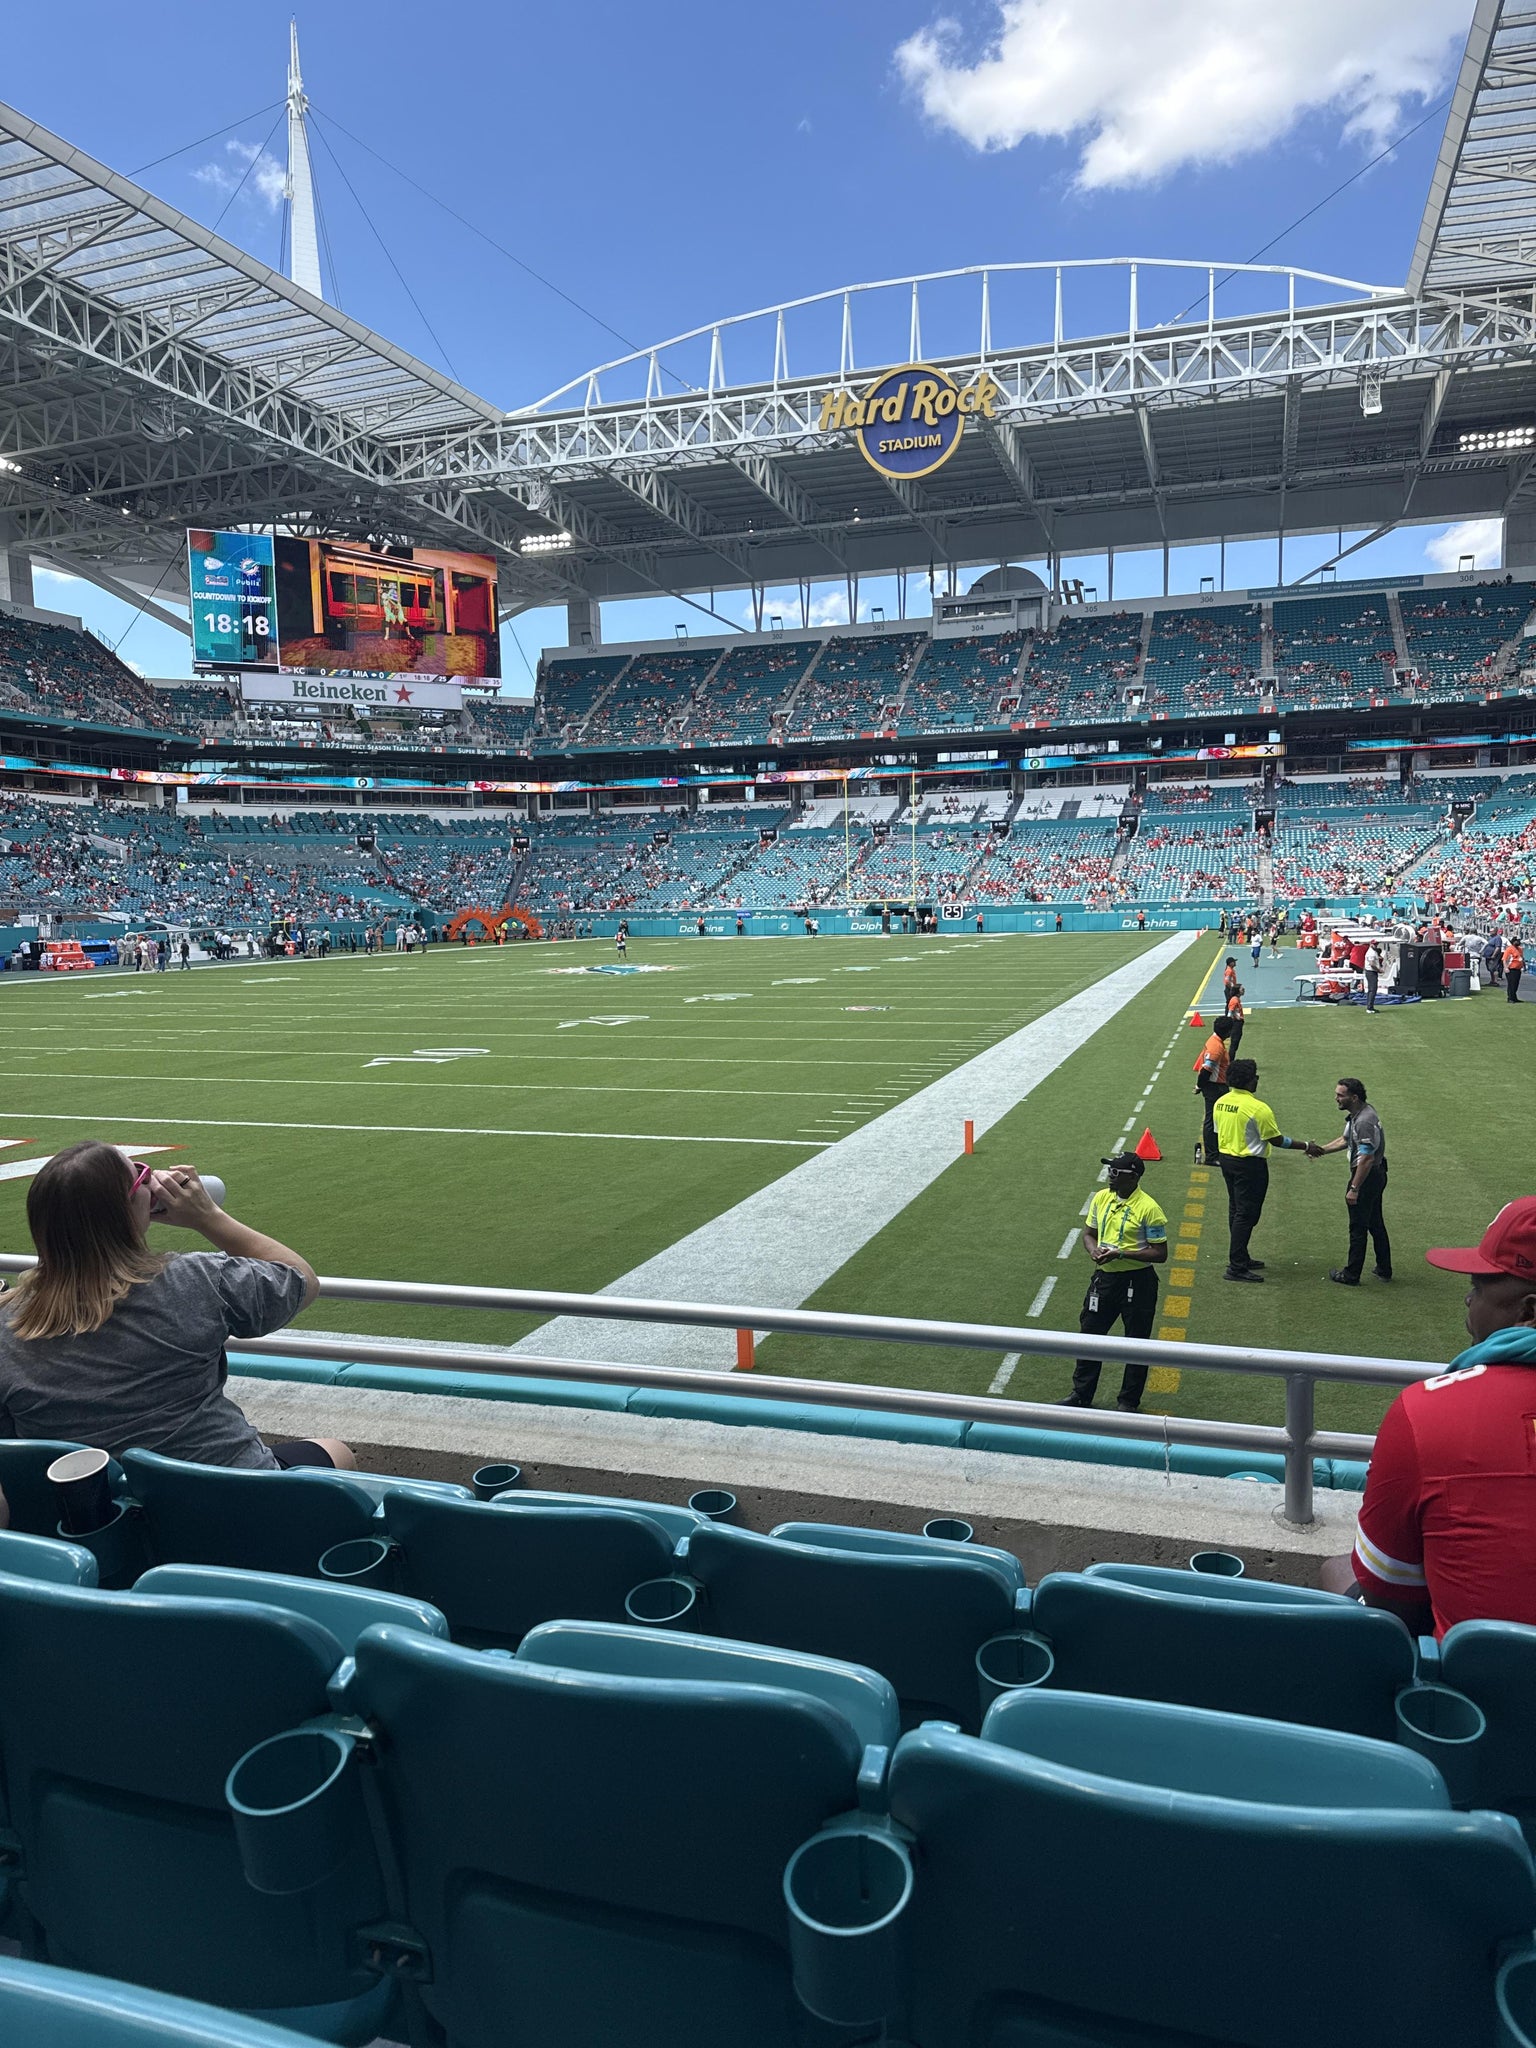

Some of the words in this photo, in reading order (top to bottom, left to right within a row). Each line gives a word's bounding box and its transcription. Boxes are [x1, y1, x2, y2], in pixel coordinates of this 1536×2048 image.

[818, 382, 908, 432] Hard
[911, 373, 998, 426] Rock
[879, 433, 942, 454] STADIUM
[1459, 574, 1475, 583] 308
[193, 591, 236, 602] COUNTDOWN
[237, 594, 247, 602] TO
[247, 596, 272, 604] KICKOFF
[1200, 595, 1214, 604] 306
[1084, 605, 1098, 613] 305
[203, 612, 270, 636] 18:18
[872, 624, 885, 632] 303
[971, 624, 984, 632] 304
[293, 666, 305, 675] KC
[320, 668, 326, 676] 0
[352, 670, 369, 678] MIA
[378, 671, 384, 679] 0
[292, 680, 388, 701] Heineken
[1309, 702, 1340, 710] STANFILL
[1341, 701, 1353, 709] 84
[1410, 697, 1428, 705] JAKE
[1430, 696, 1453, 704] SCOTT
[1183, 711, 1196, 719] JIM
[1197, 709, 1231, 717] MANDICH
[944, 905, 961, 918] 25
[850, 921, 899, 932] Dolphs
[1121, 918, 1179, 928] Dohins
[1225, 1103, 1240, 1114] TEAM
